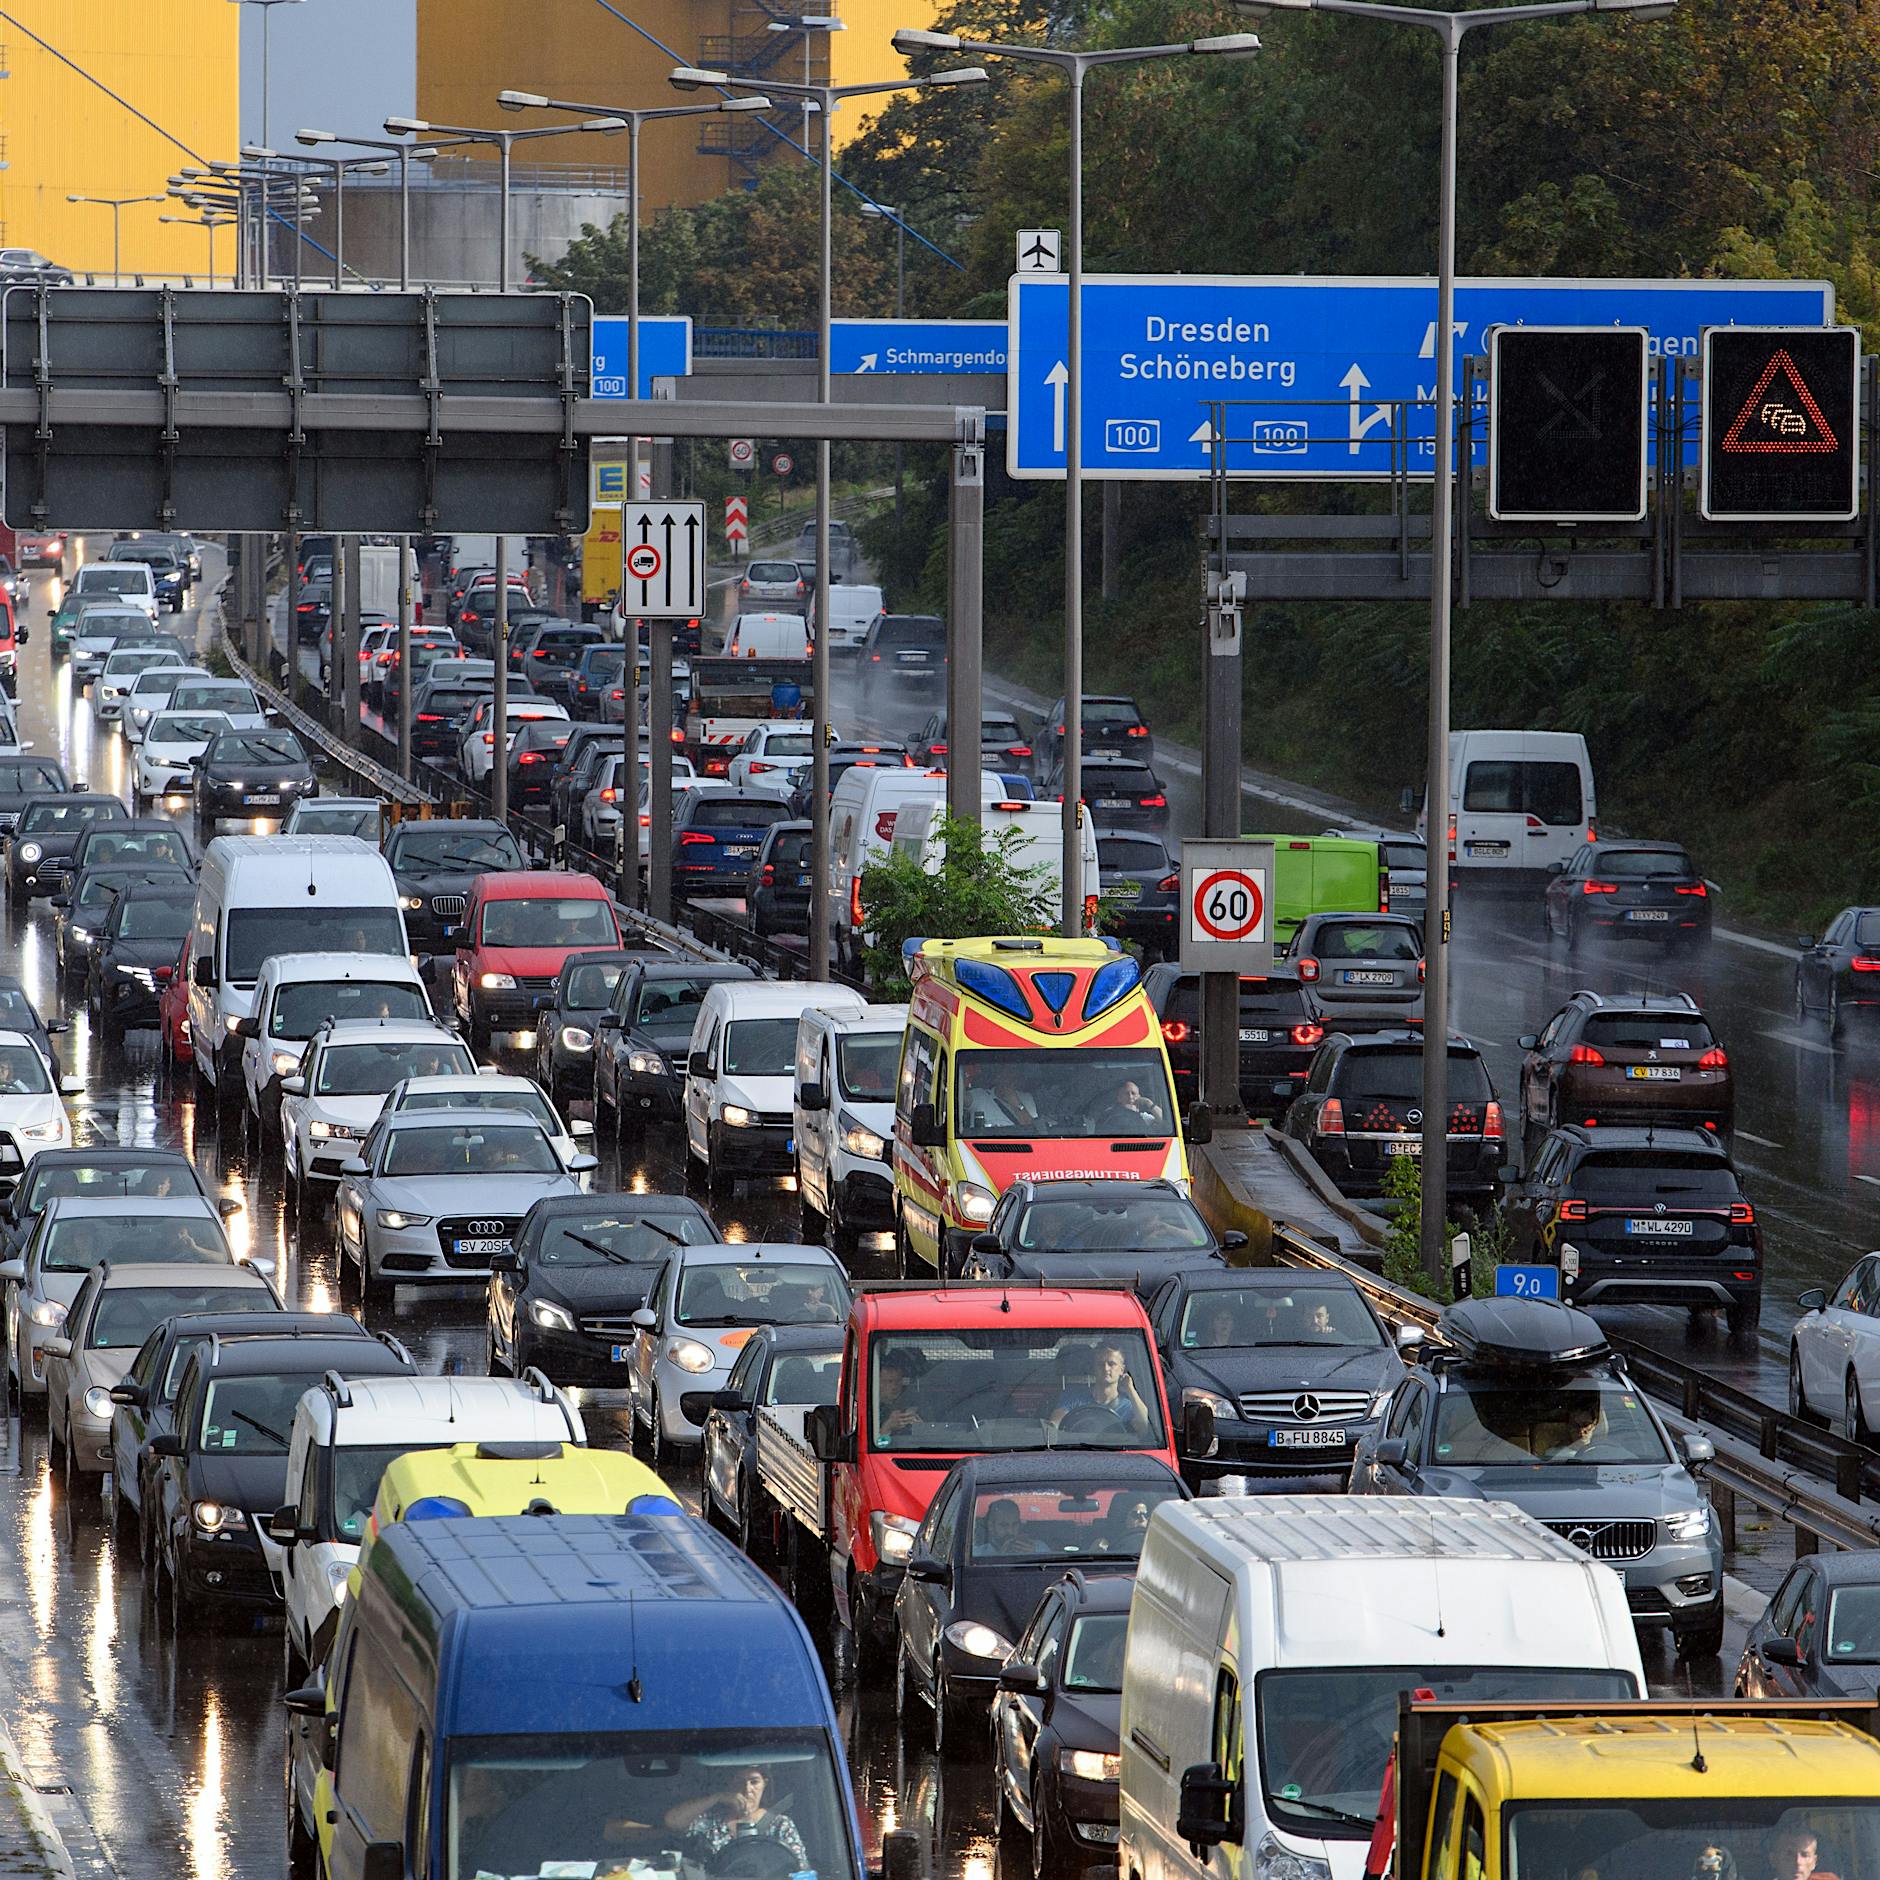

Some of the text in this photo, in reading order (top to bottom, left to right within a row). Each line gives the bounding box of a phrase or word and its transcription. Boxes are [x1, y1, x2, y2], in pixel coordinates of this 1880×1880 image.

[1146, 316, 1270, 342] Dresden
[1648, 336, 1698, 355] gen
[886, 348, 1008, 368] Schmargendo
[1119, 353, 1296, 387] Schöneberg
[598, 380, 620, 392] 100
[1115, 426, 1151, 446] 100
[1263, 427, 1299, 447] 100
[600, 467, 624, 492] E
[1210, 890, 1248, 921] 60
[1350, 972, 1356, 981] B
[1372, 973, 1392, 982] 2709
[1244, 1030, 1267, 1040] 5510
[1633, 1067, 1679, 1077] CV 17 836
[1390, 1143, 1397, 1153] B
[1403, 1144, 1416, 1154] EC
[1633, 1221, 1691, 1233] M WL 4290
[461, 1241, 476, 1252] SV
[1513, 1273, 1541, 1296] 9,0
[1277, 1431, 1344, 1445] B FU 8845
